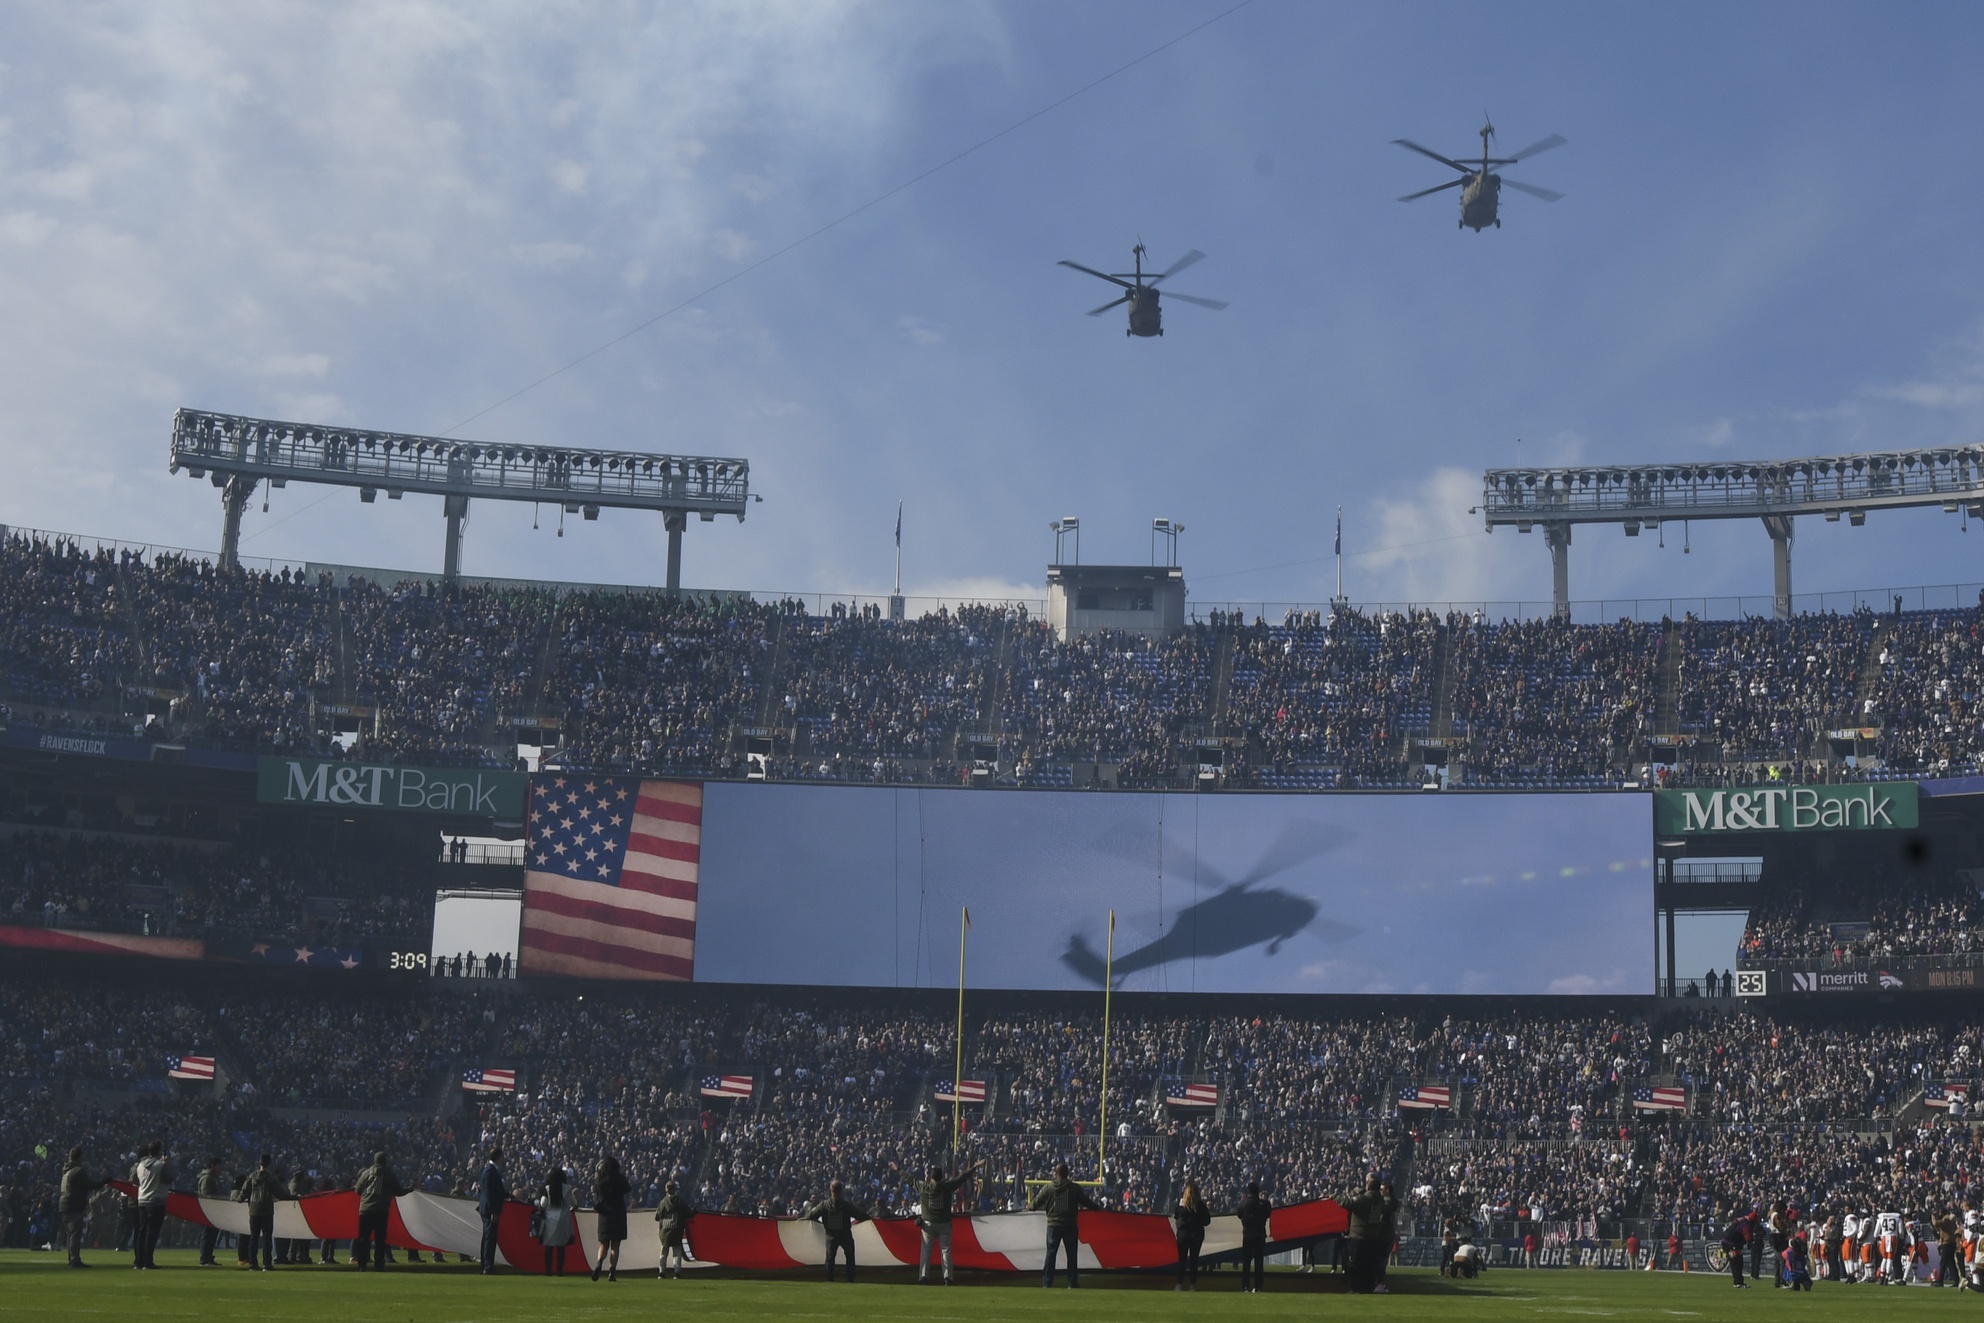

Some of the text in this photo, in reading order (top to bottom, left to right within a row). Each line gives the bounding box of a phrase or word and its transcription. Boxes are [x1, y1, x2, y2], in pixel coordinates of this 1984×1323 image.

[1843, 730, 1856, 738] BAY
[40, 734, 106, 754] #RAVENSFLOCK
[283, 762, 498, 812] M&T Bank
[1682, 786, 1893, 830] M&T Bank
[390, 951, 427, 969] 3:09
[1740, 975, 1761, 992] 25
[1820, 971, 1869, 985] merritt
[1928, 970, 1974, 986] MON 8:15 PM
[1882, 1218, 1896, 1231] 43
